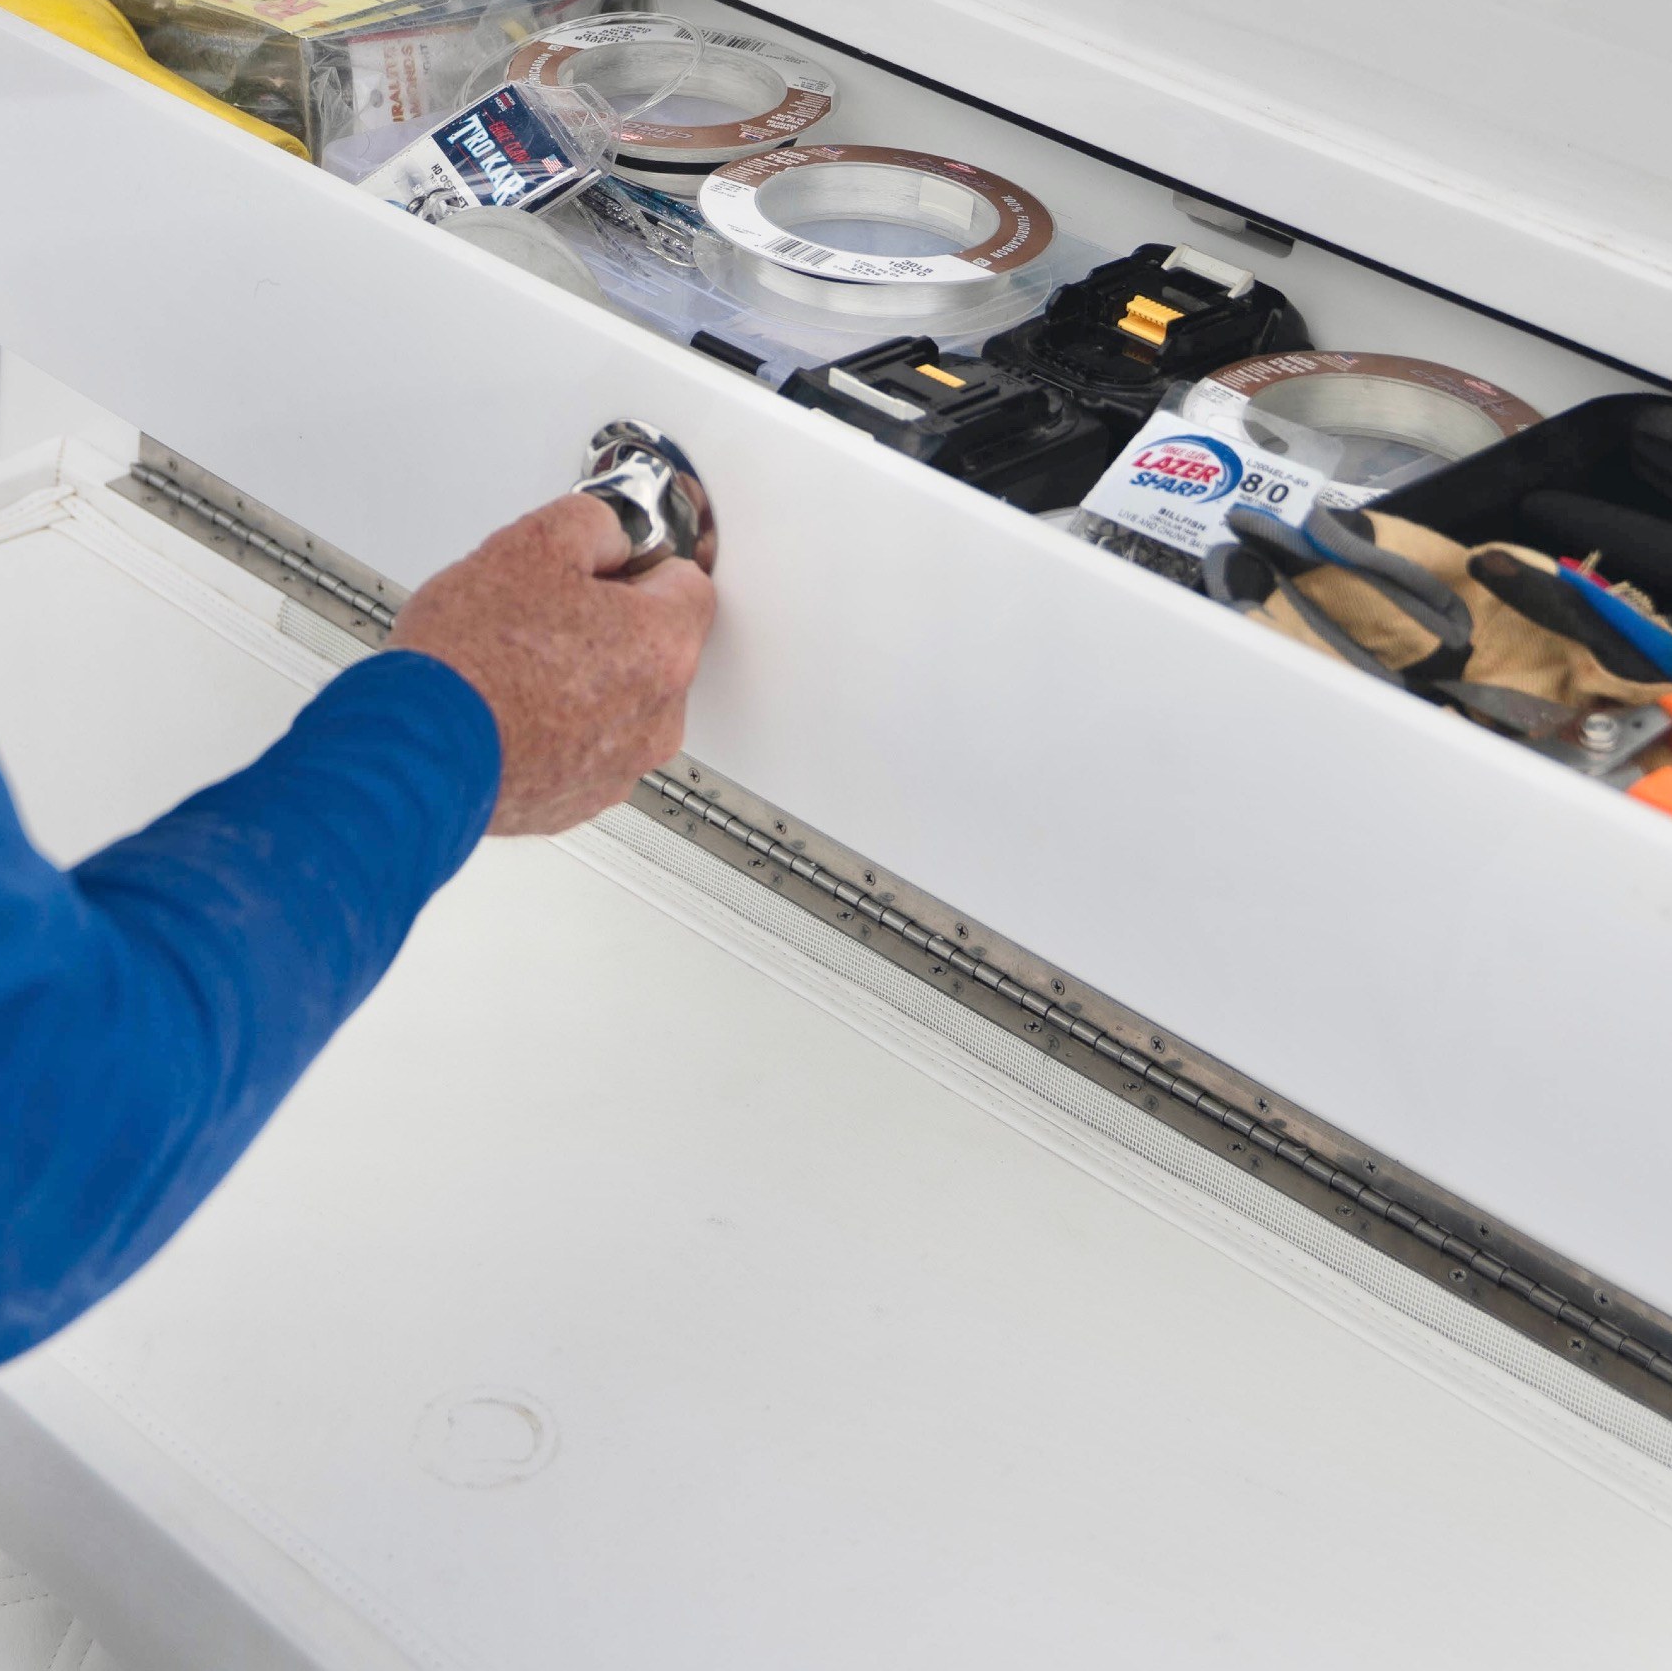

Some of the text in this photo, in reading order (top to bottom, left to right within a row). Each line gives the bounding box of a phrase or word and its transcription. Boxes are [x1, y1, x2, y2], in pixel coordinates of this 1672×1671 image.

[444, 113, 529, 207] TROKAR
[989, 215, 1031, 260] FLUOROCARBON
[1131, 450, 1220, 483] LAZER
[1129, 471, 1208, 499] SHARP
[1239, 473, 1290, 504] 8/0
[1157, 507, 1207, 531] BILLFISH
